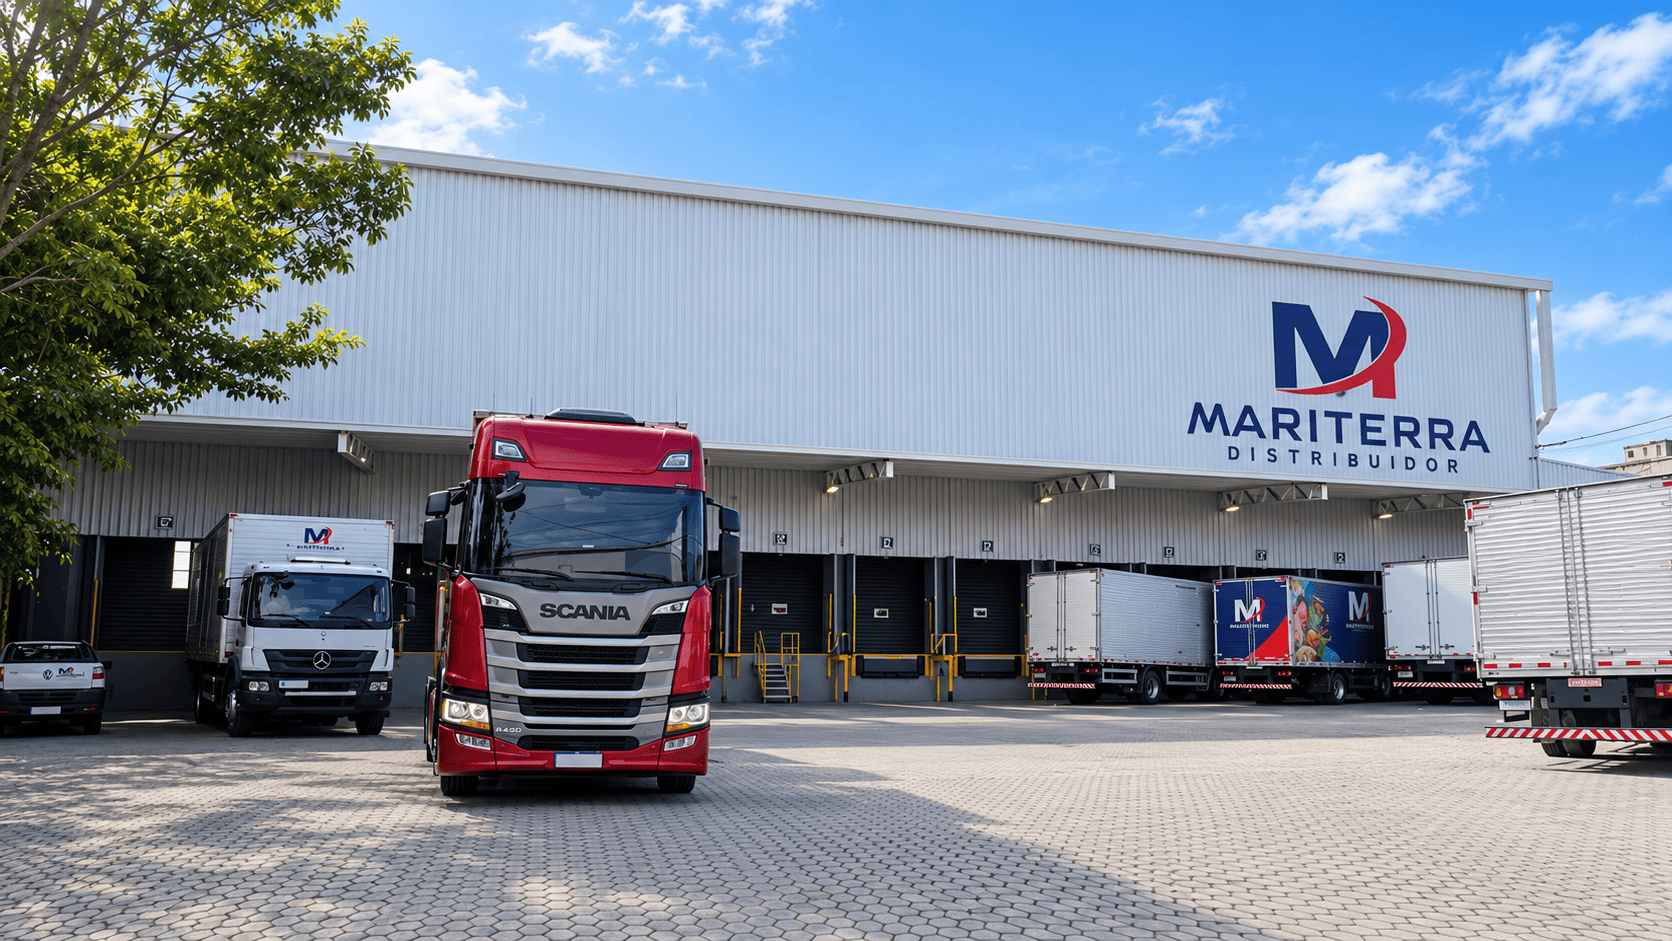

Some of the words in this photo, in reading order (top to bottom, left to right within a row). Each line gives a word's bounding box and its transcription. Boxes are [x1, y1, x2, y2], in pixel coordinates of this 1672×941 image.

[1187, 401, 1491, 454] MARITERRA
[1228, 445, 1458, 473] DISTRIBUIDOR
[539, 602, 632, 621] SCANIA
